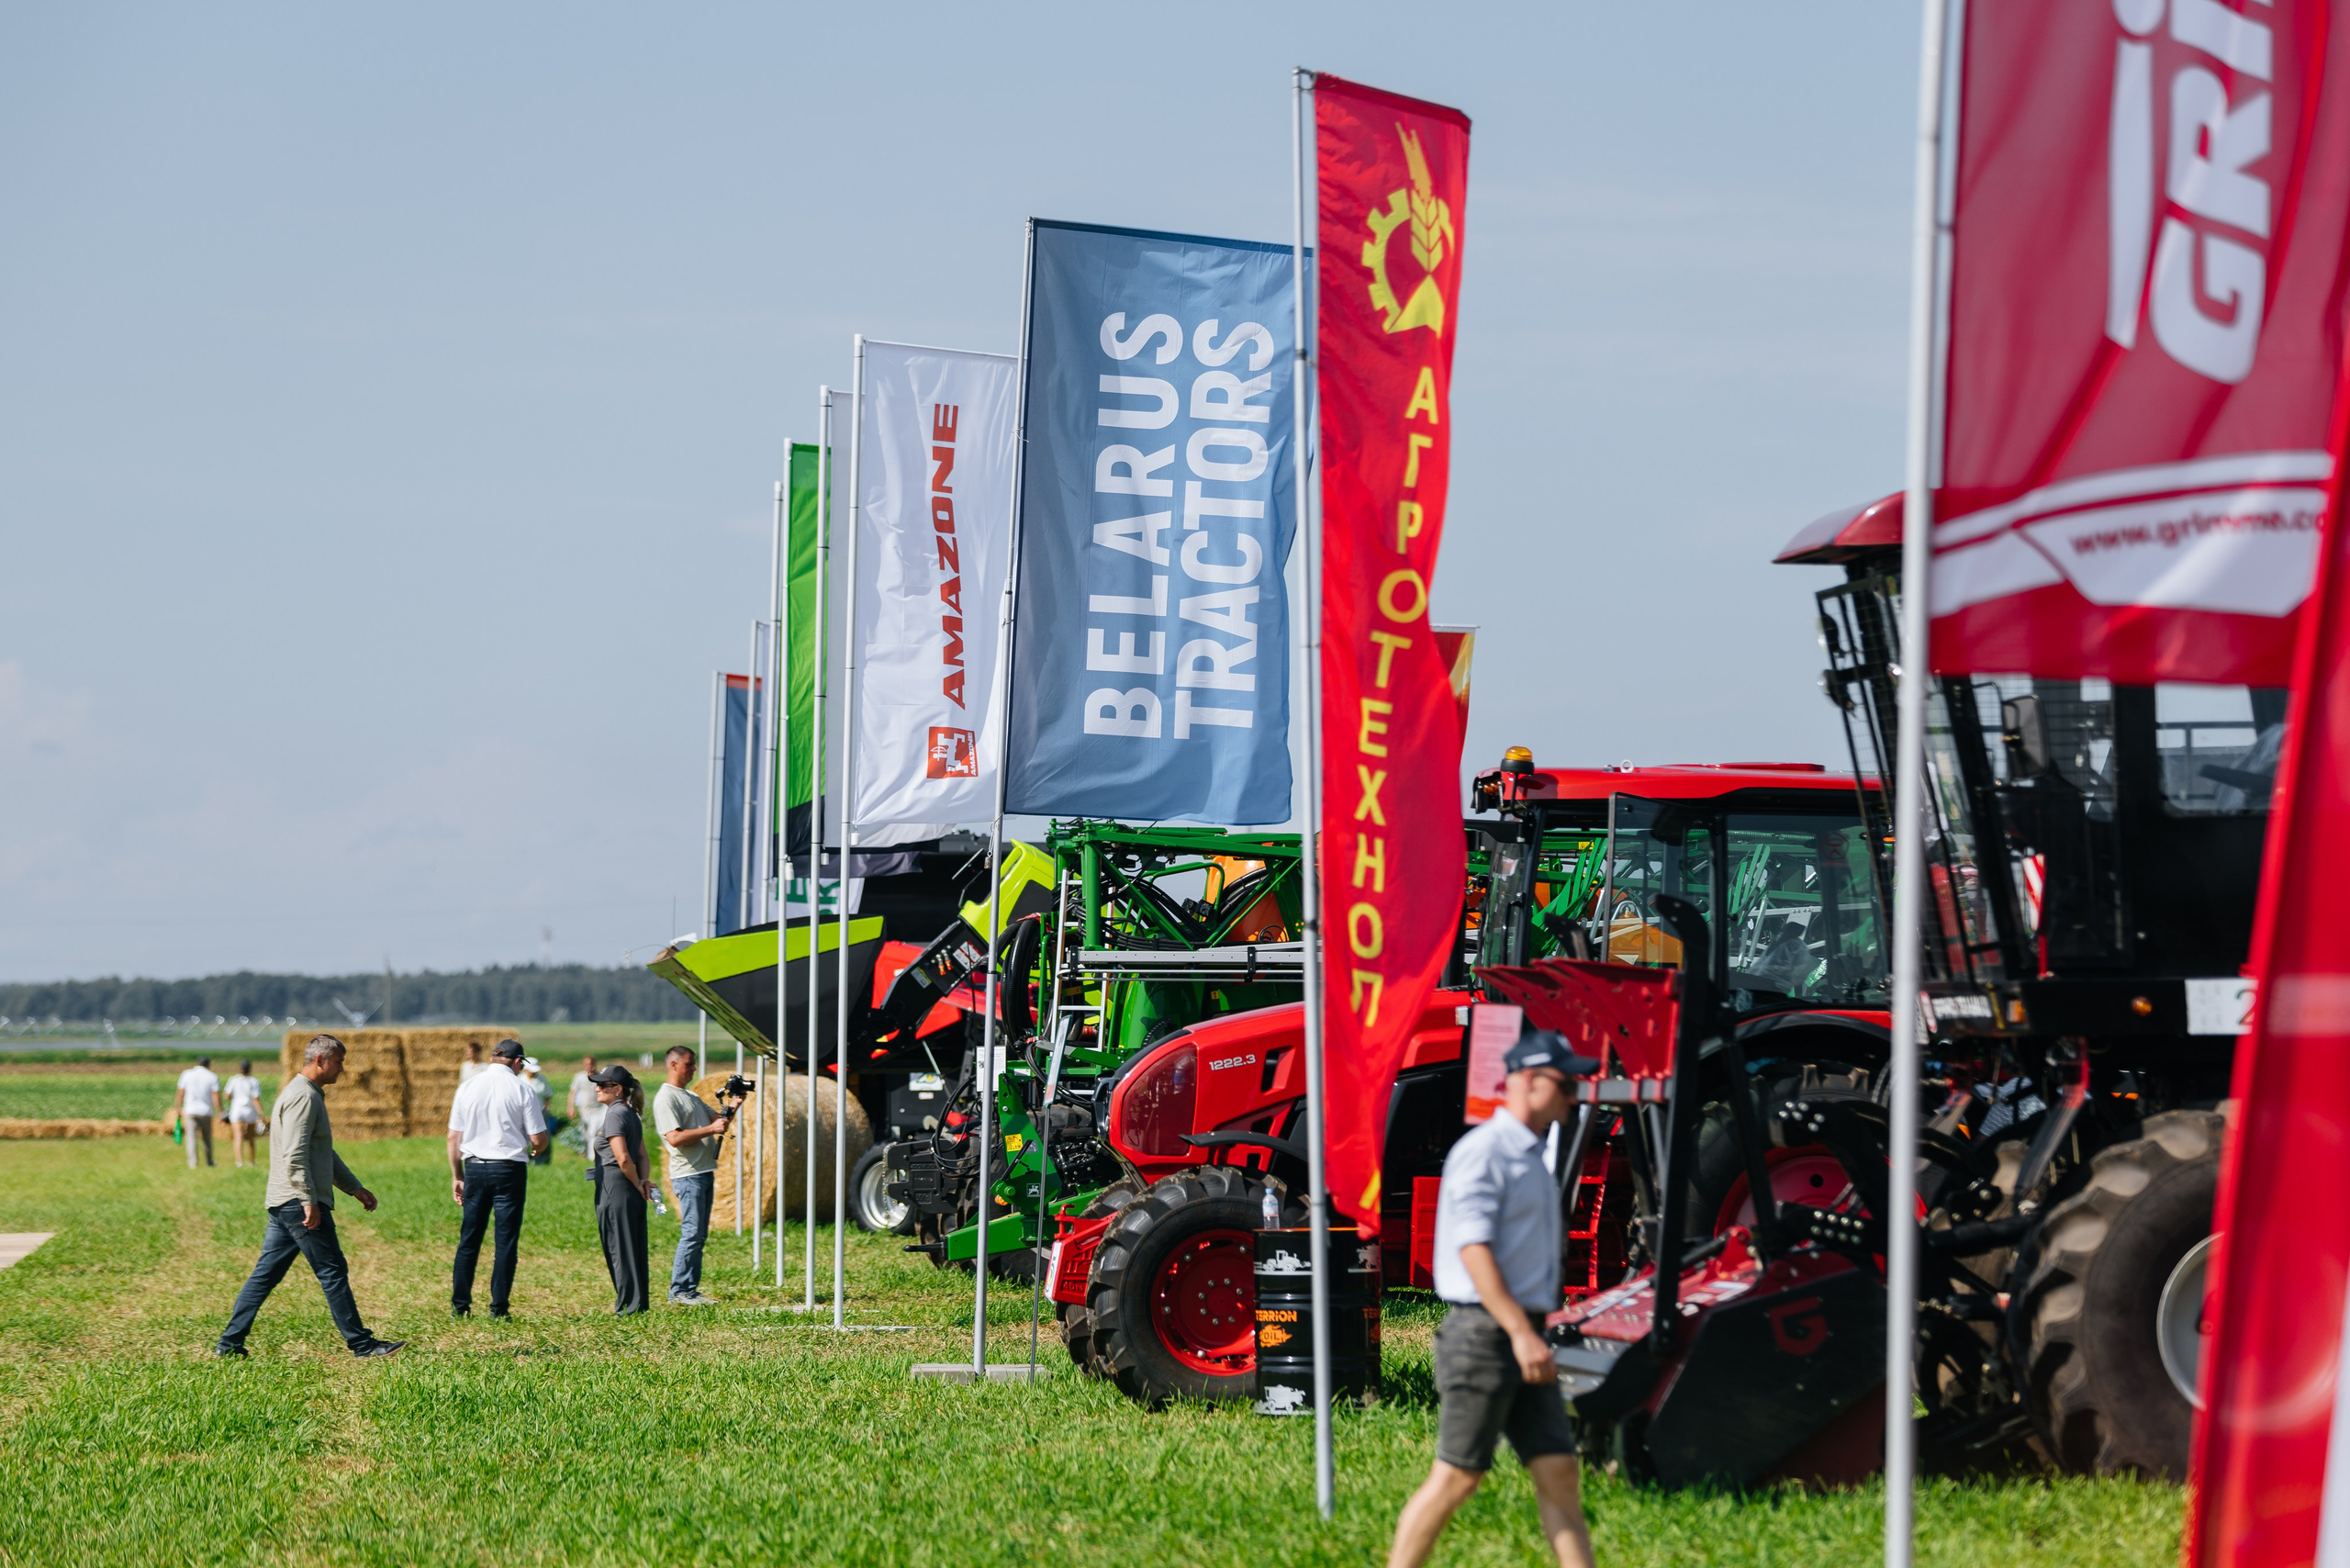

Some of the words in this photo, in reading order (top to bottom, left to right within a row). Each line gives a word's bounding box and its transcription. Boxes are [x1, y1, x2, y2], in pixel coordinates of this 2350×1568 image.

[2147, 0, 2274, 385] GRI
[932, 403, 967, 711] AMAZONE
[1083, 312, 1184, 739] BELARUS
[1173, 319, 1275, 740] TRACTORS
[967, 732, 977, 777] AMAZONE
[1208, 1053, 1257, 1071] 1222.3
